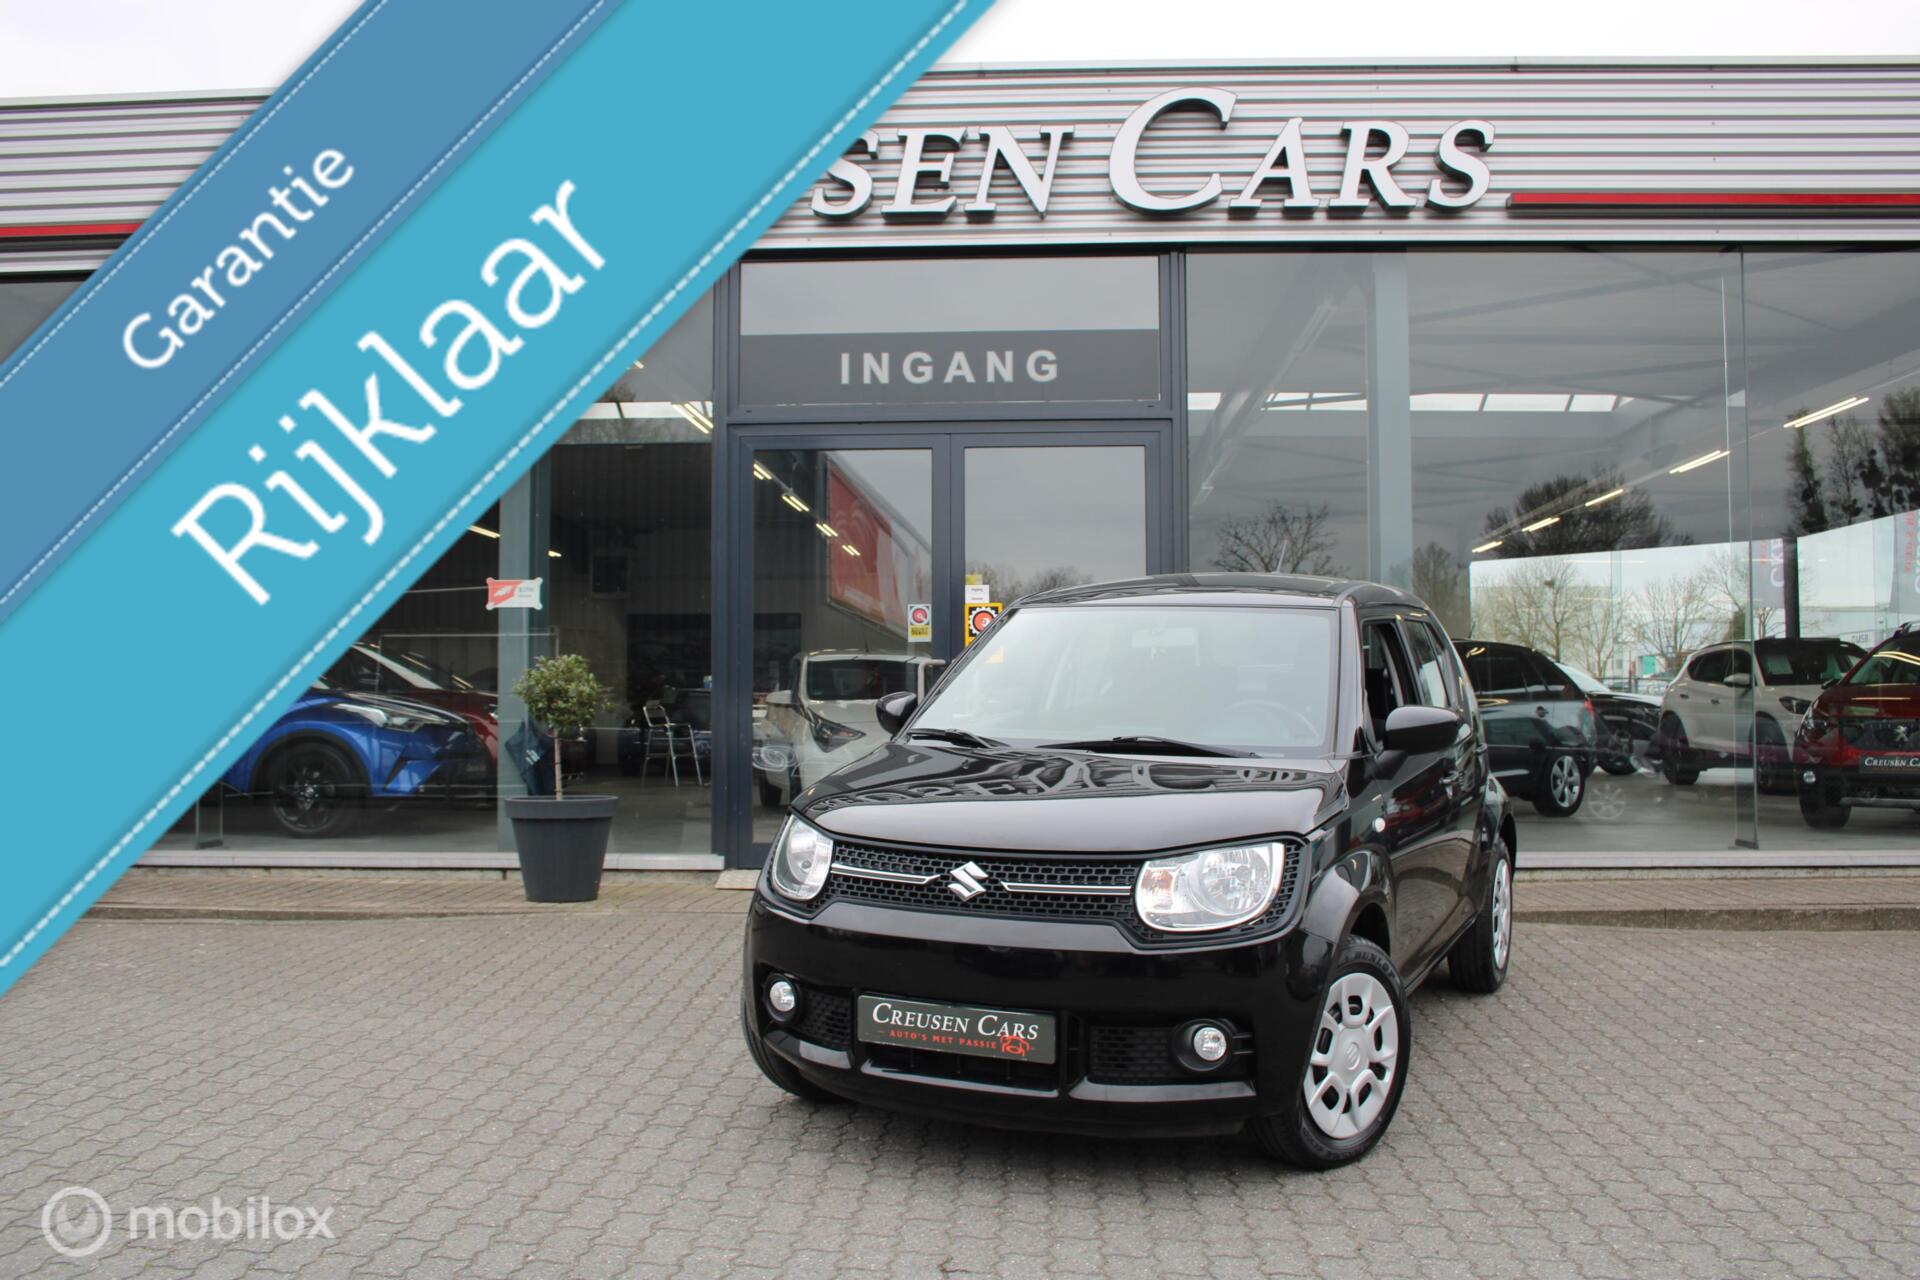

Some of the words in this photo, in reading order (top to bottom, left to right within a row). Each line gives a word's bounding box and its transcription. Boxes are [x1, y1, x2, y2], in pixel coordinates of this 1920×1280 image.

[841, 350, 1058, 384] INGANG
[872, 1002, 970, 1033] CREUSEN
[978, 1014, 1039, 1040] CARS
[888, 1029, 929, 1041] AUTO'S
[932, 1034, 954, 1044] MET
[959, 1038, 997, 1049] PASSIE
